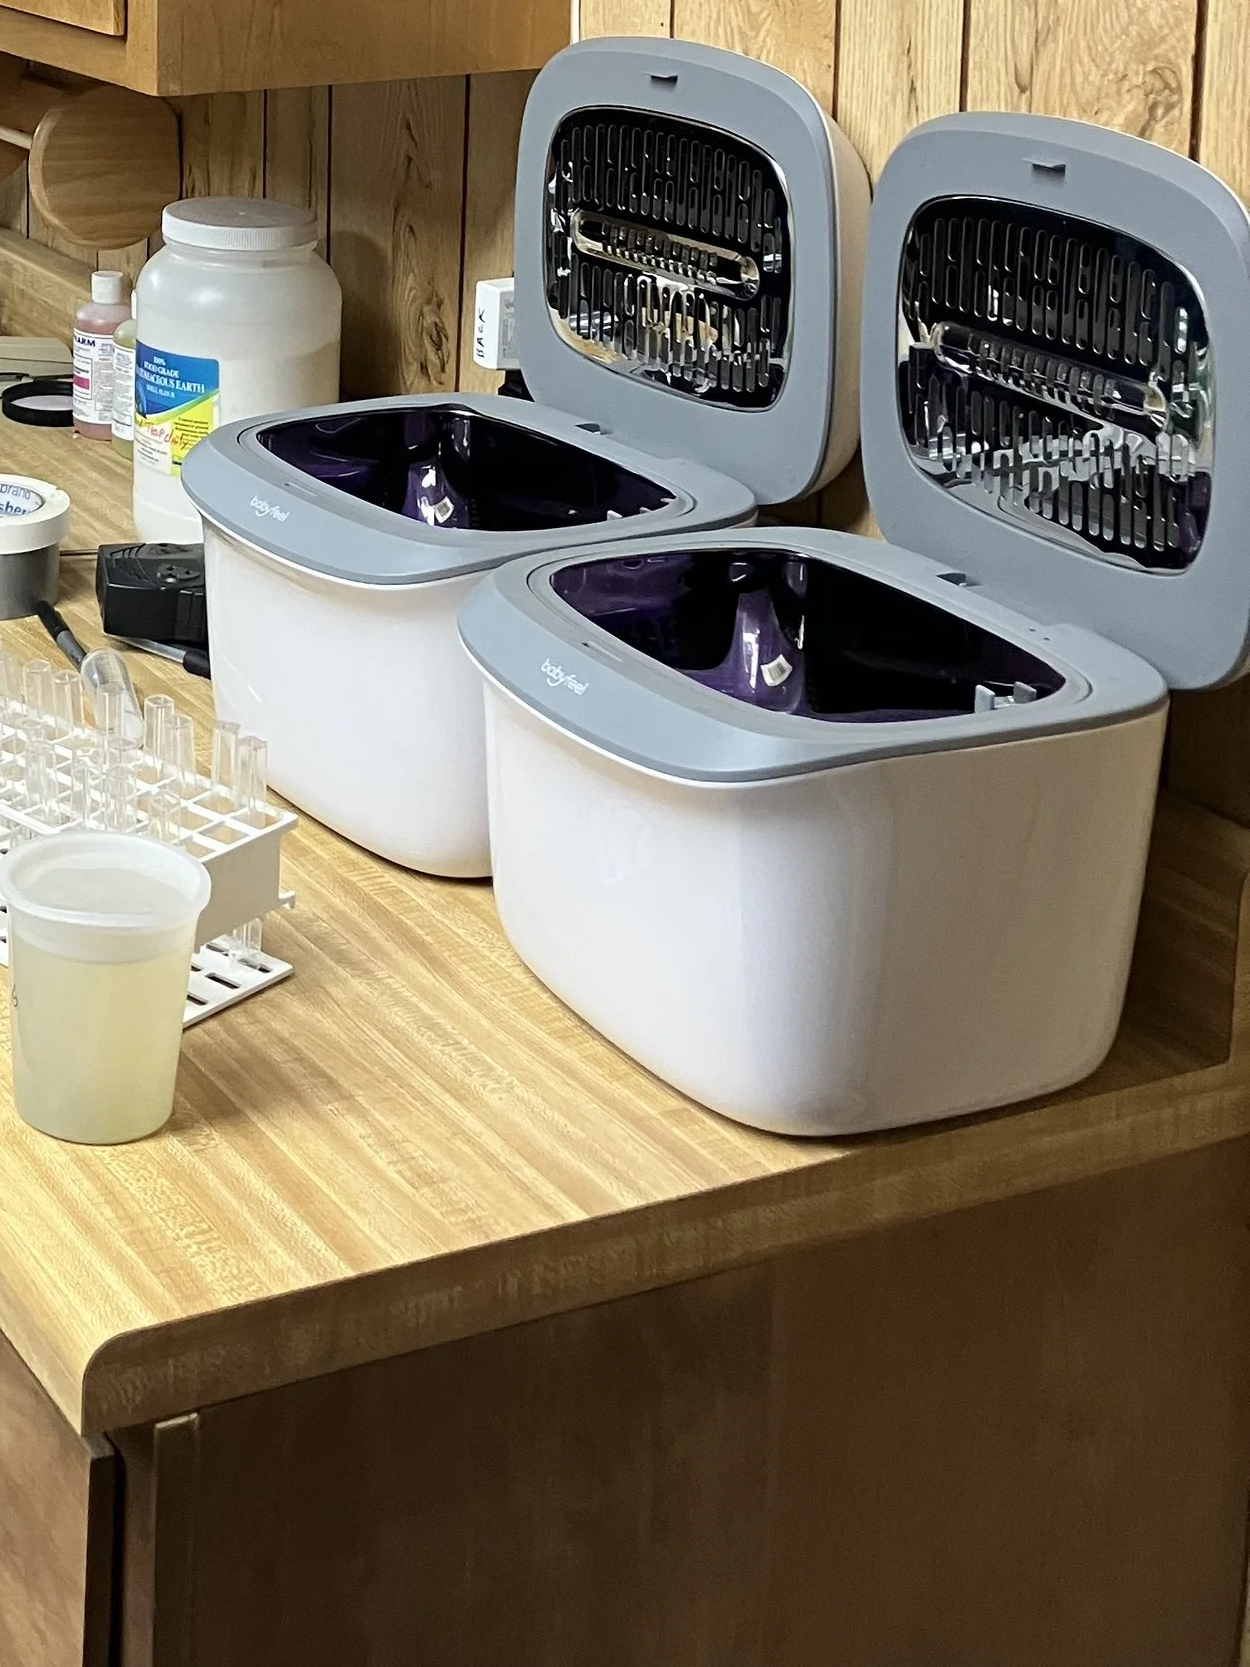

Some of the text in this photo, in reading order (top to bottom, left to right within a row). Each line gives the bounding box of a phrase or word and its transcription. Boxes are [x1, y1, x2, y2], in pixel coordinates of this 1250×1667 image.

[158, 366, 180, 378] GRADE
[175, 380, 205, 394] EARTH
[250, 494, 290, 522] babyfeel
[540, 657, 590, 696] babyfeel
